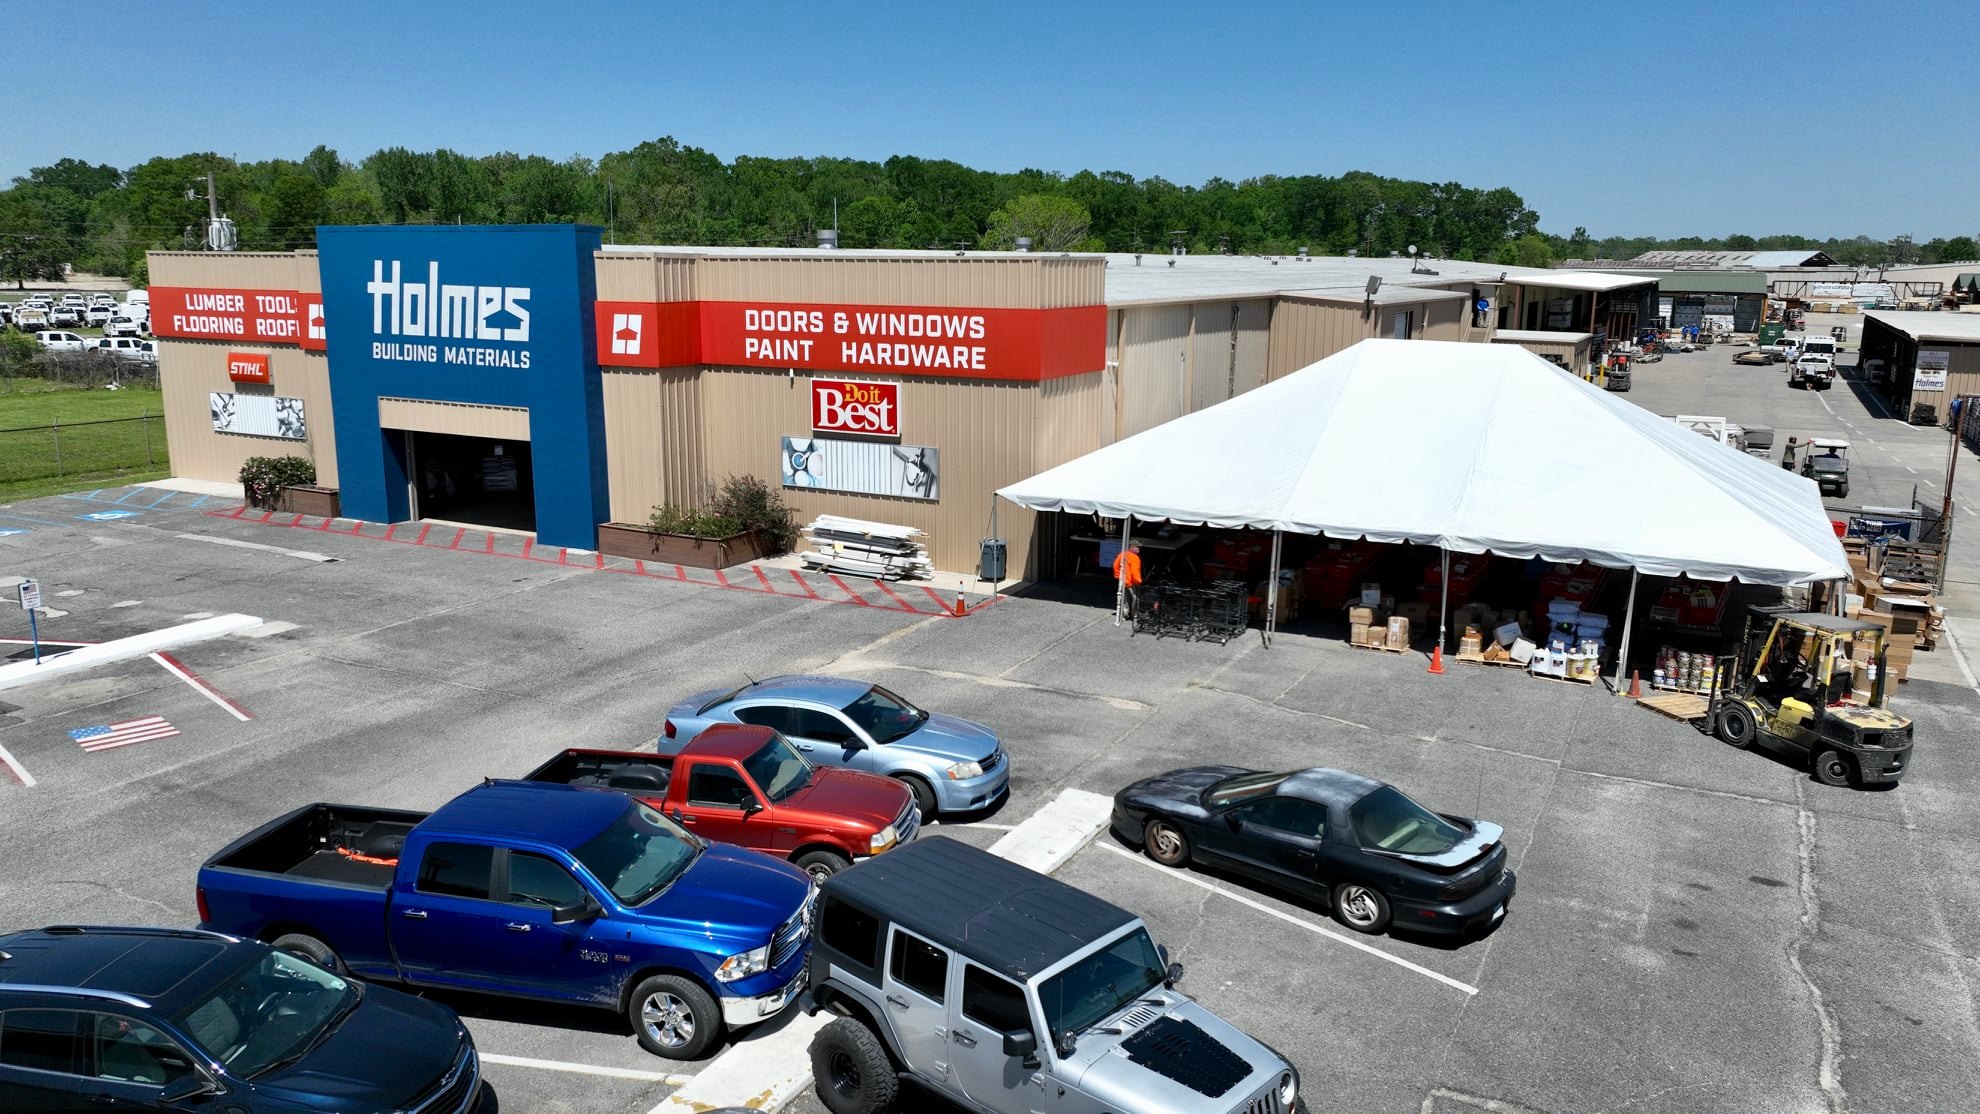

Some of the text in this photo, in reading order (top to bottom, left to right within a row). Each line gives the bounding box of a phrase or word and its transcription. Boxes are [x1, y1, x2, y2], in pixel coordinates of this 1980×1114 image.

[185, 293, 298, 314] LUMBER TOOL
[367, 259, 531, 342] Holmes
[173, 315, 244, 335] FLOORING
[745, 309, 985, 339] DOORS & WINDOWS
[372, 342, 530, 369] BUILDING MATERIALS
[745, 337, 986, 370] PAINT HARDWARE
[230, 361, 264, 376] STIHL
[843, 383, 881, 403] Do it
[1915, 378, 1944, 388] Holmes
[815, 388, 894, 431] Best
